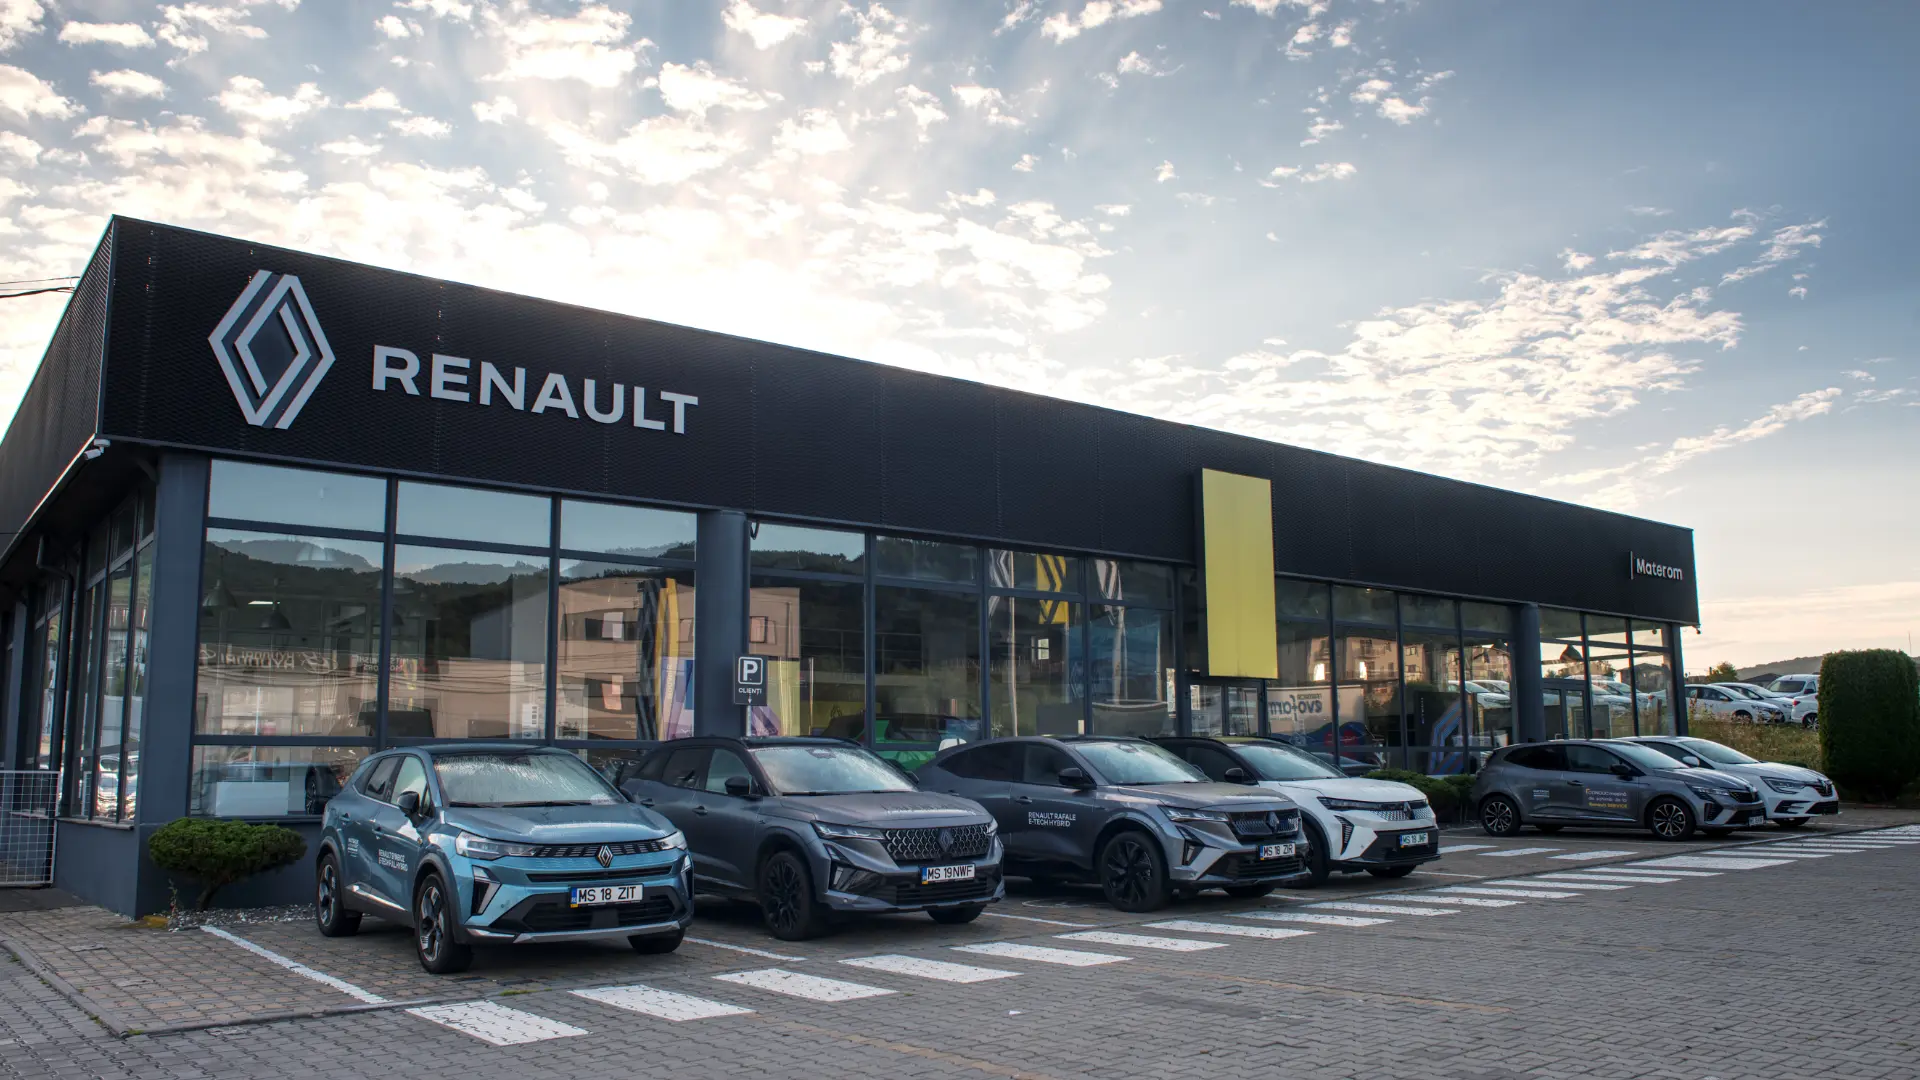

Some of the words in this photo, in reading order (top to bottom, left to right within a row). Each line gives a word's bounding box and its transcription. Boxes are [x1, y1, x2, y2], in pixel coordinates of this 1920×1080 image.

[372, 344, 699, 434] RENAULT
[1636, 558, 1683, 581] Materom
[743, 660, 758, 681] P
[1028, 811, 1053, 819] RENAULT
[1054, 813, 1076, 821] RAFALE
[927, 868, 941, 880] MS
[578, 889, 596, 903] MS
[600, 887, 612, 901] 18
[617, 886, 637, 900] ZIT
